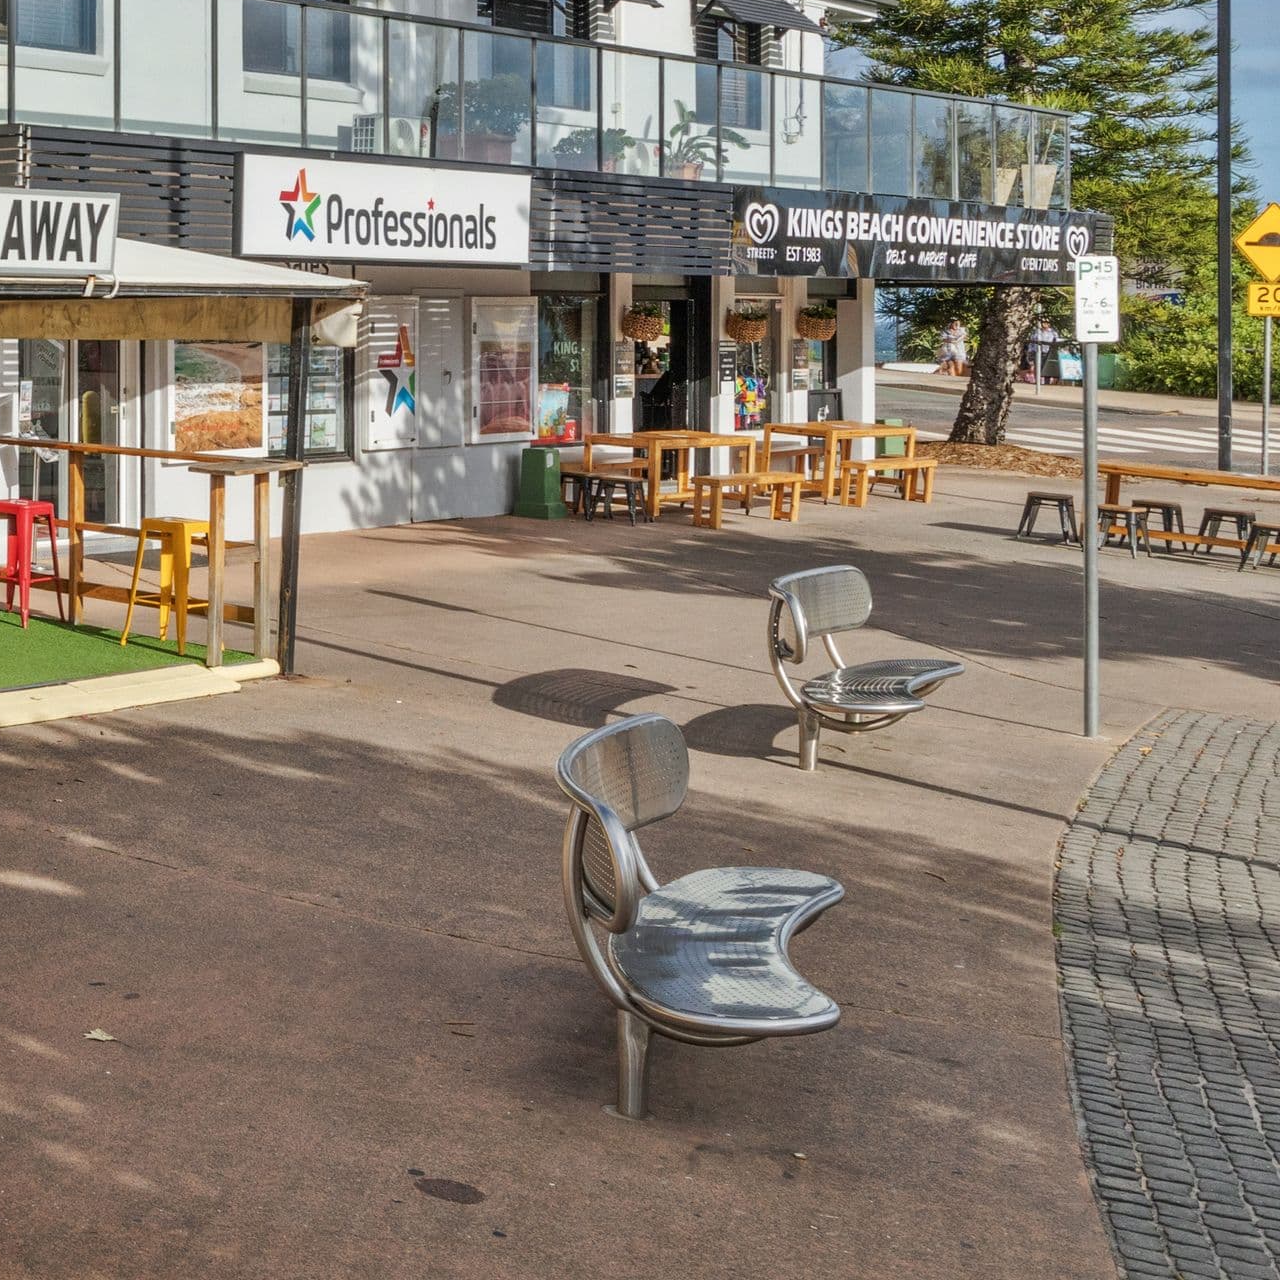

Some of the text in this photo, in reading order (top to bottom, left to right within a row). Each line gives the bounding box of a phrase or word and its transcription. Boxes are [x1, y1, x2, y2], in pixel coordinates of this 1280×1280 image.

[0, 199, 111, 263] AWAY
[326, 193, 497, 250] Professionals
[787, 208, 1061, 251] KINGS BEACH CONVENIENCE STORE
[746, 247, 775, 259] STREETS
[786, 246, 821, 262] EST 1983
[886, 249, 907, 265] DELI
[917, 250, 948, 267] MARKET
[1079, 261, 1093, 280] P
